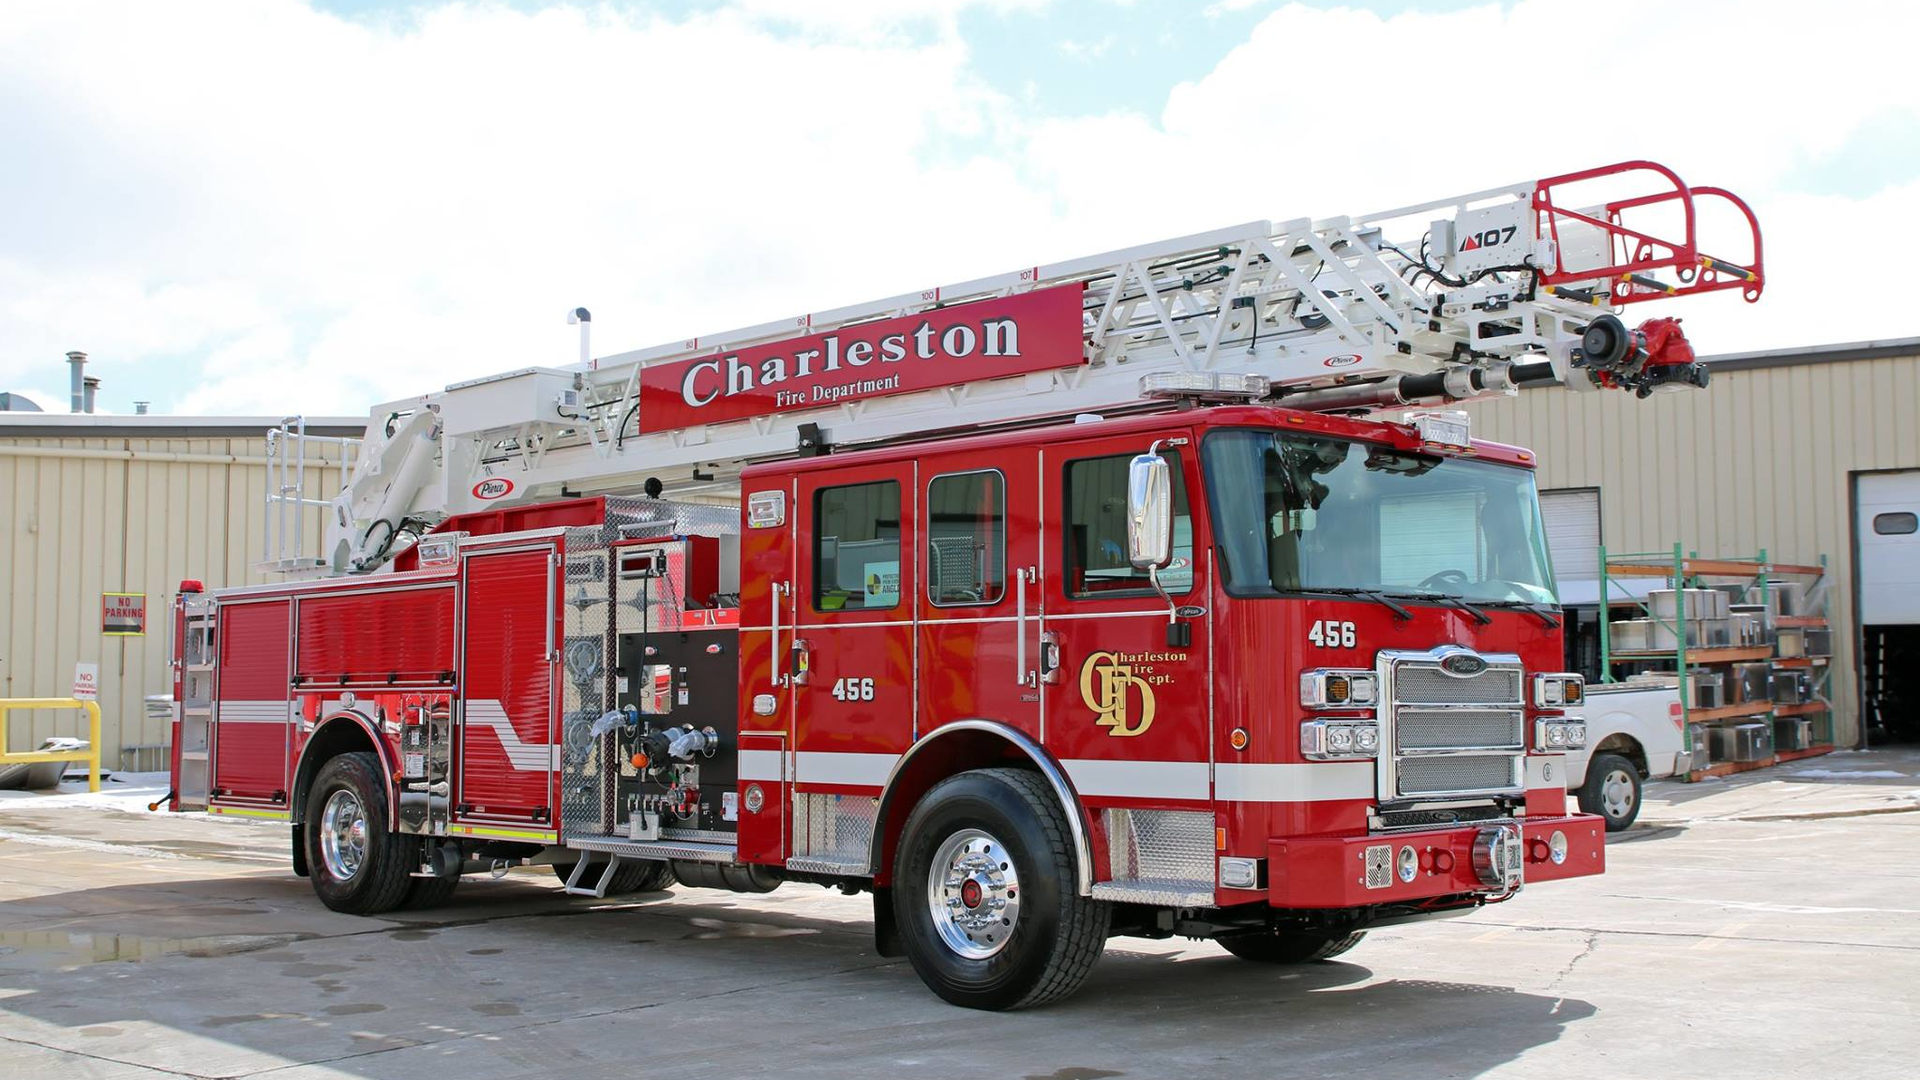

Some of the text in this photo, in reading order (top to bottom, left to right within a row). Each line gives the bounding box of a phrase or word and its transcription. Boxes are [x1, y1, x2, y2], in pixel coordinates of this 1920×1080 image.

[1020, 270, 1032, 281] 107
[921, 291, 934, 301] 100
[797, 317, 806, 327] 90
[681, 317, 1022, 408] Charleston
[776, 373, 900, 408] Fire Department
[481, 482, 504, 496] Pierce
[118, 597, 131, 607] NO
[105, 608, 143, 618] PARKING
[1308, 620, 1356, 648] 456
[79, 673, 93, 682] NO
[832, 678, 875, 701] 456
